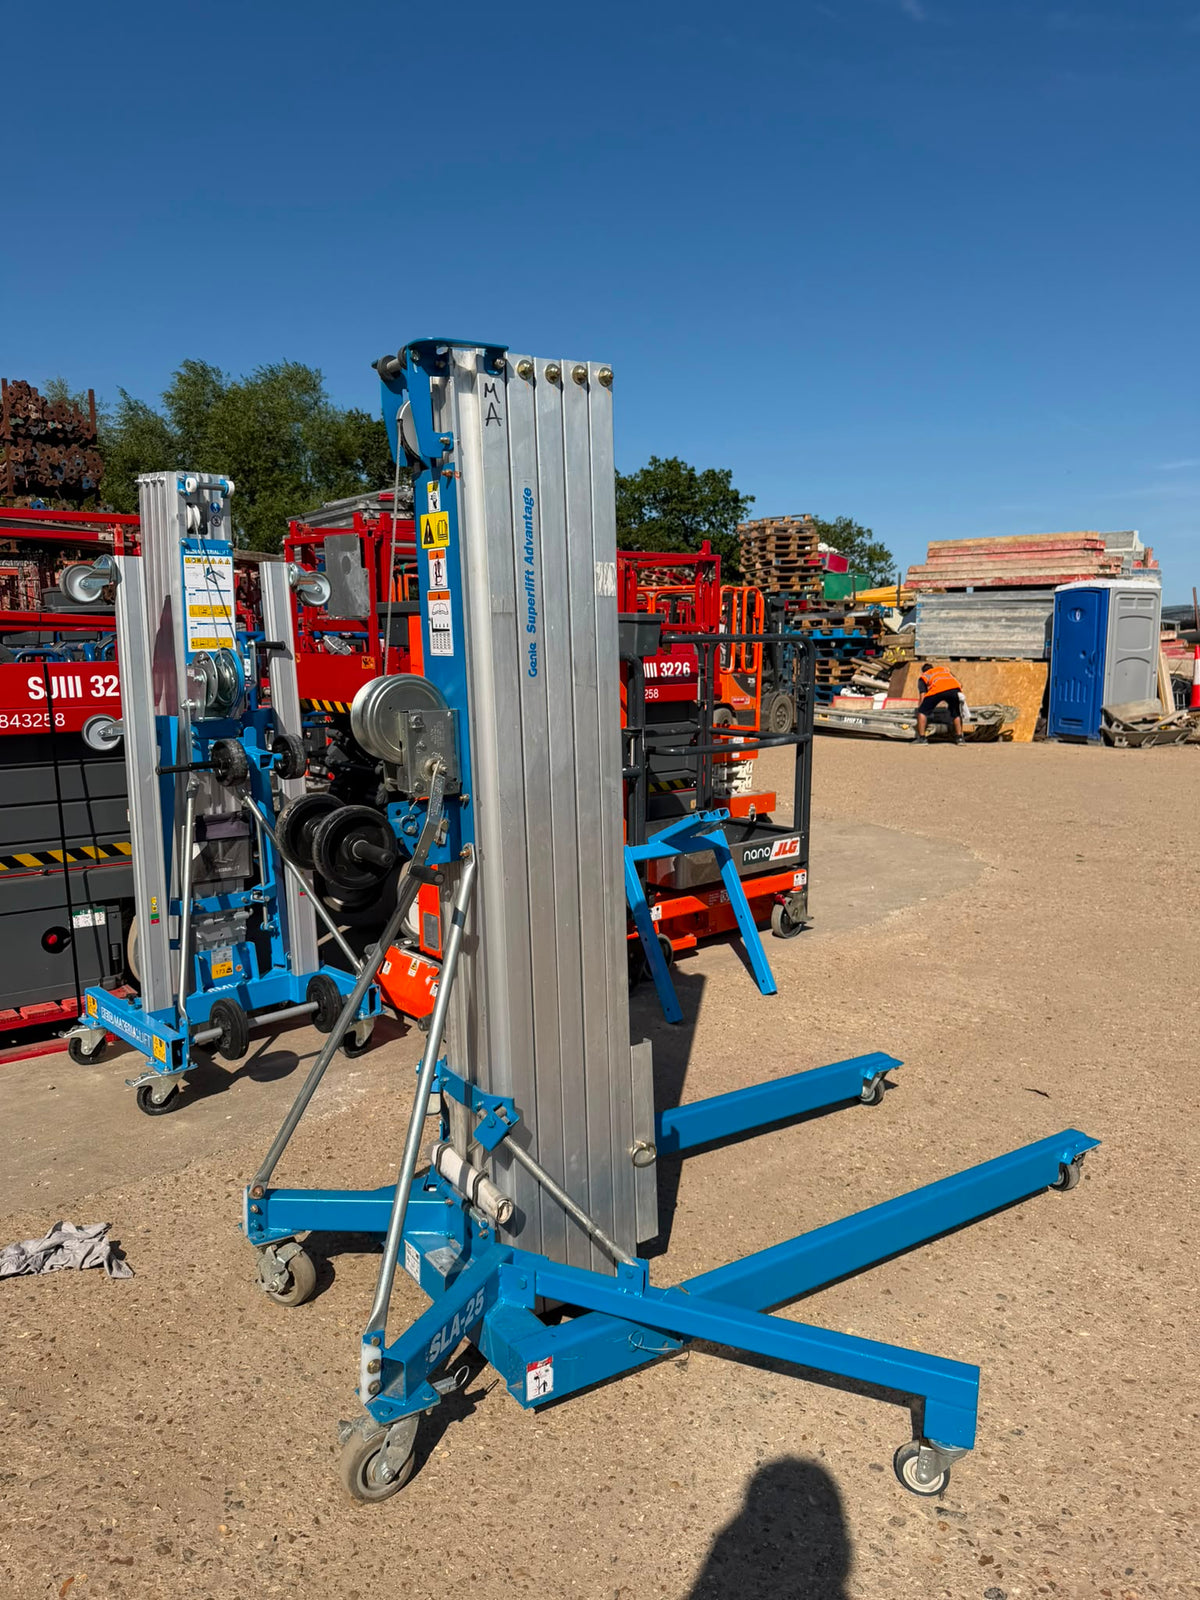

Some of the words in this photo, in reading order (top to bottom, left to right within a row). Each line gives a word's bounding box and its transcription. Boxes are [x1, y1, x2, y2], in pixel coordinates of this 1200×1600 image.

[523, 487, 535, 566] Advantage
[525, 569, 537, 634] Superlift
[528, 642, 537, 678] Genie
[660, 662, 690, 677] 3226
[27, 676, 83, 700] SJIII
[90, 675, 120, 697] 32
[0, 713, 66, 729] 843258
[743, 847, 771, 861] nano
[774, 840, 799, 857] JLG
[429, 1286, 486, 1364] SLA-25
